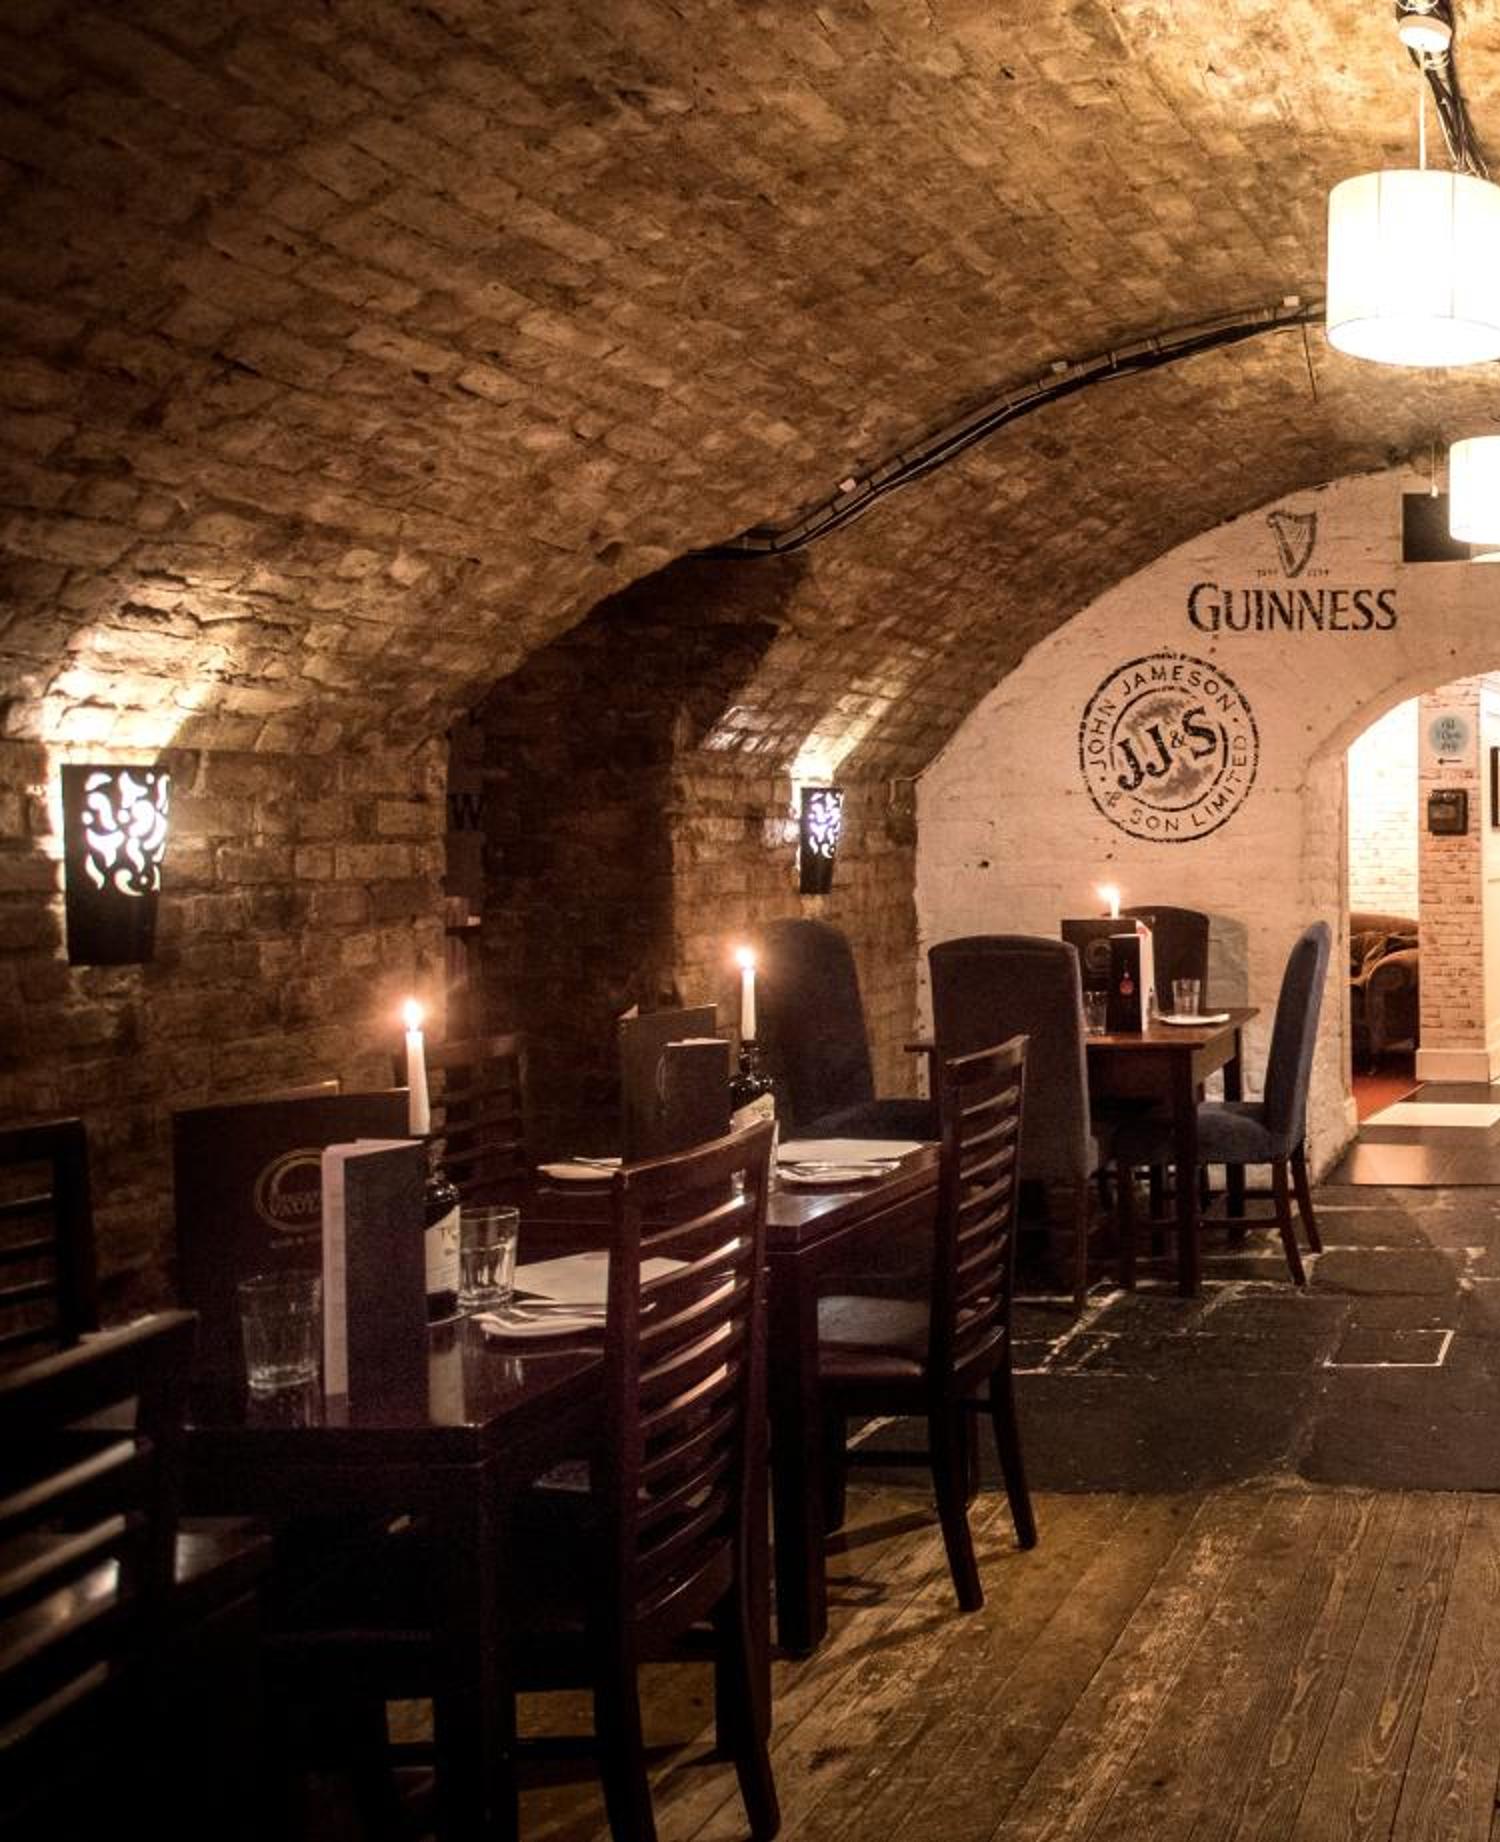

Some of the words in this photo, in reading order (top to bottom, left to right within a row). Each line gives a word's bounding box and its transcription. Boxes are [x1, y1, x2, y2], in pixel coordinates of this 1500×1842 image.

[1187, 582, 1398, 632] GUINNESS
[1088, 699, 1117, 769] JOHN
[1122, 665, 1237, 712] JAMESON
[1129, 808, 1179, 832] SON
[1192, 735, 1248, 827] LIMITED
